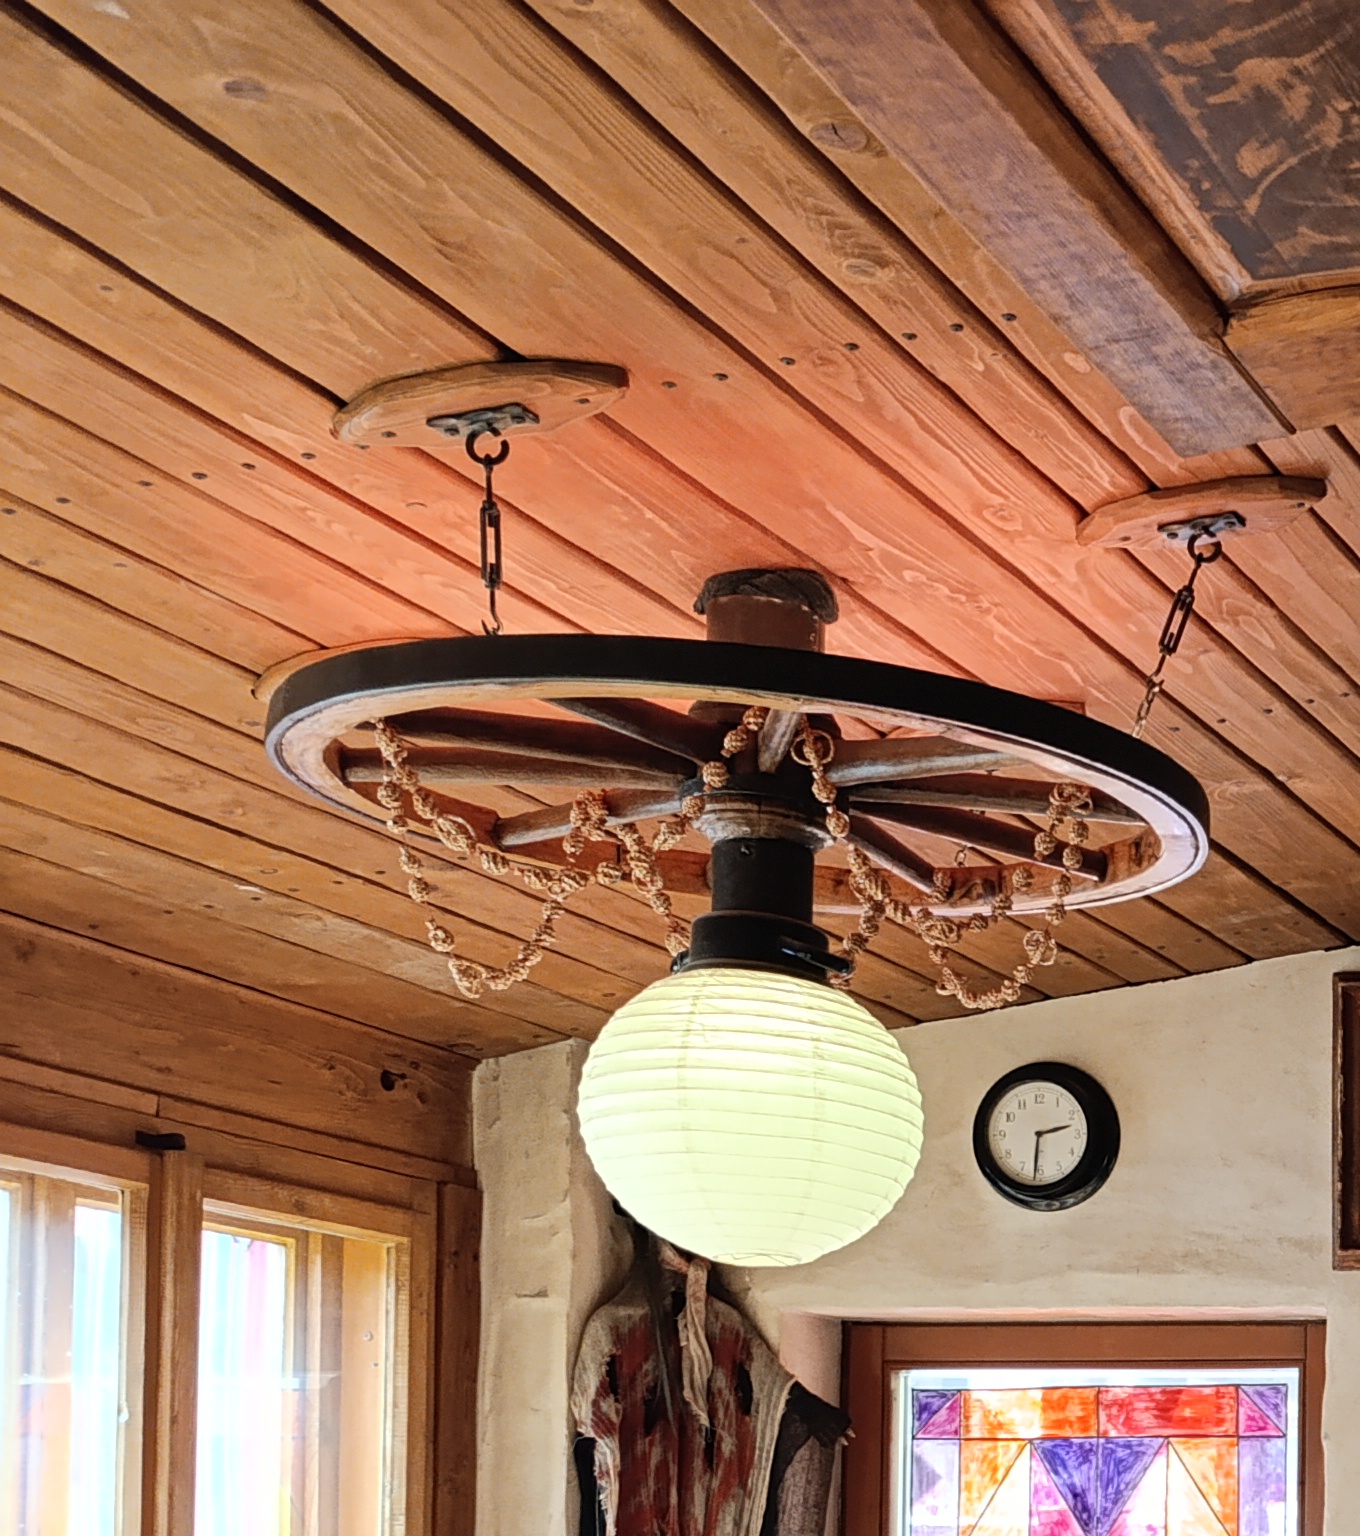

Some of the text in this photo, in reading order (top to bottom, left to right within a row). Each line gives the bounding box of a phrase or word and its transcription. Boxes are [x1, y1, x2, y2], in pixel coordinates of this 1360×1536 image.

[1034, 1093, 1046, 1104] 12
[1055, 1097, 1060, 1108] 1
[1017, 1099, 1027, 1110] 11
[1005, 1112, 1016, 1123] 10
[1068, 1110, 1076, 1121] 2
[998, 1129, 1006, 1140] 9
[1073, 1129, 1081, 1139] 3
[1004, 1148, 1012, 1159] 8
[1068, 1147, 1075, 1157] 4
[1019, 1161, 1026, 1172] 7
[1037, 1165, 1045, 1176] 6
[1055, 1161, 1062, 1172] 5
